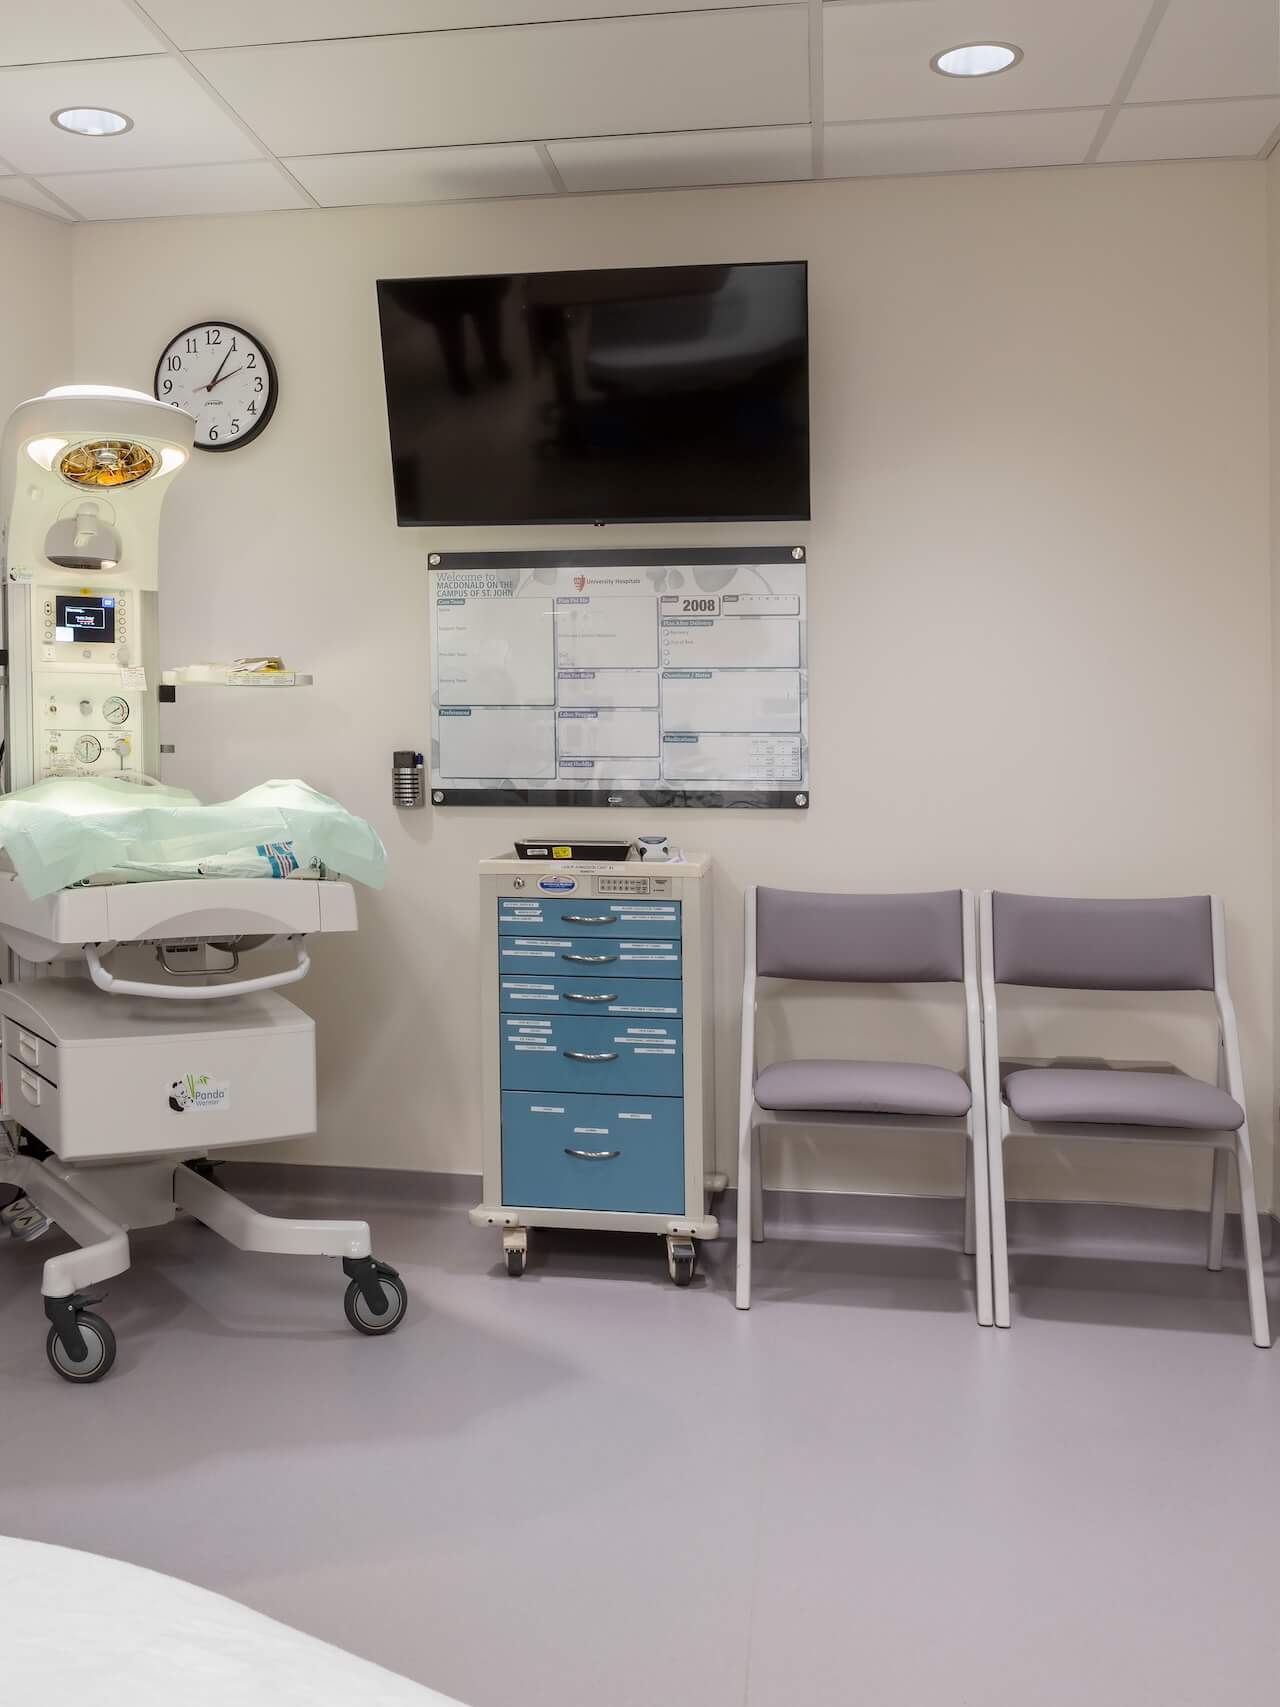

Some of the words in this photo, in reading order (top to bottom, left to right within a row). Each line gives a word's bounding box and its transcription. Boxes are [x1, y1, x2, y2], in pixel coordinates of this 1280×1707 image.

[206, 329, 222, 345] 12
[231, 336, 238, 352] 1
[186, 338, 199, 354] 11
[167, 355, 182, 371] 10
[246, 353, 257, 369] 2
[163, 379, 173, 395] 9
[254, 376, 264, 393] 3
[246, 400, 257, 415] 4
[209, 424, 219, 441] 6
[230, 418, 240, 434] 5
[436, 571, 483, 582] Welcome
[485, 571, 497, 582] to
[615, 577, 641, 585] Hospitals
[436, 581, 485, 590] MACDONALD
[486, 581, 499, 589] ON
[500, 580, 513, 589] THE
[436, 589, 468, 598] CAMPUS
[470, 589, 480, 597] OF
[481, 589, 493, 597] ST.
[494, 589, 514, 597] JOHN
[682, 599, 716, 612] 2008
[195, 1089, 225, 1100] Panda
